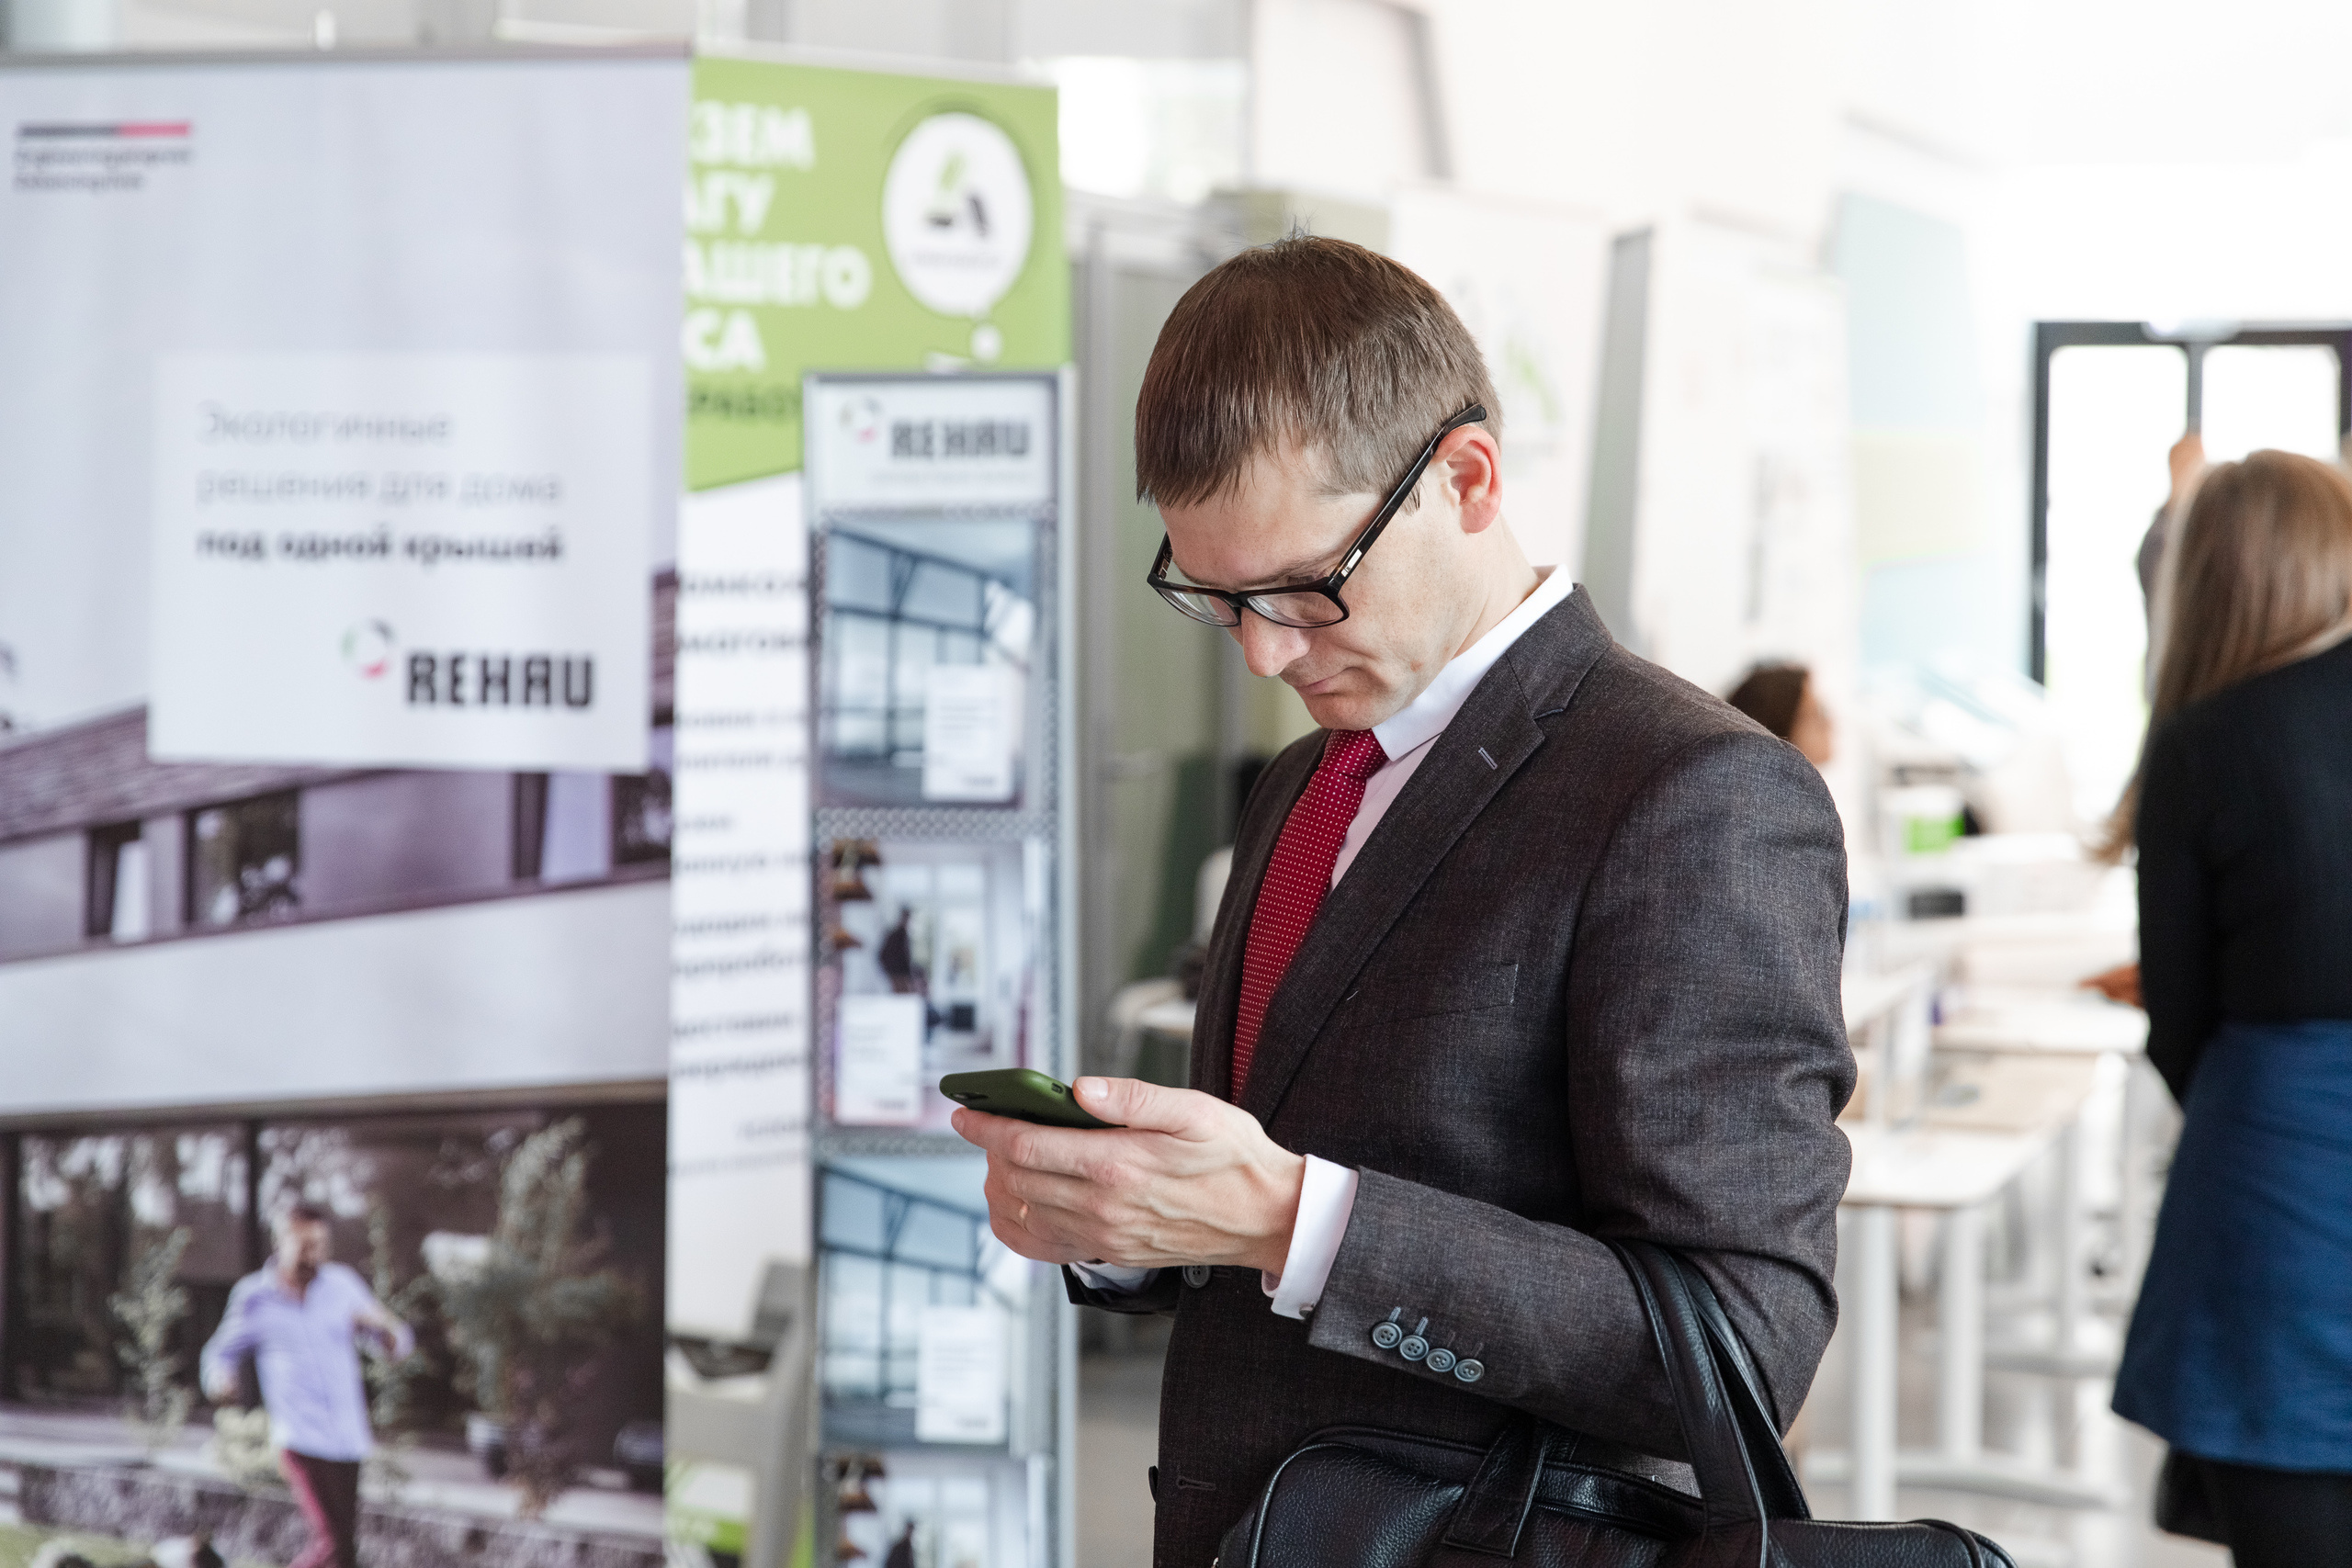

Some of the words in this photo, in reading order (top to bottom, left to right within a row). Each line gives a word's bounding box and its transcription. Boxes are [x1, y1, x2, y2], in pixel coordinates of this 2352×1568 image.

[889, 419, 1032, 459] REHAU
[277, 522, 392, 562] одной
[401, 524, 564, 571] крышей
[406, 650, 595, 709] REHAU
